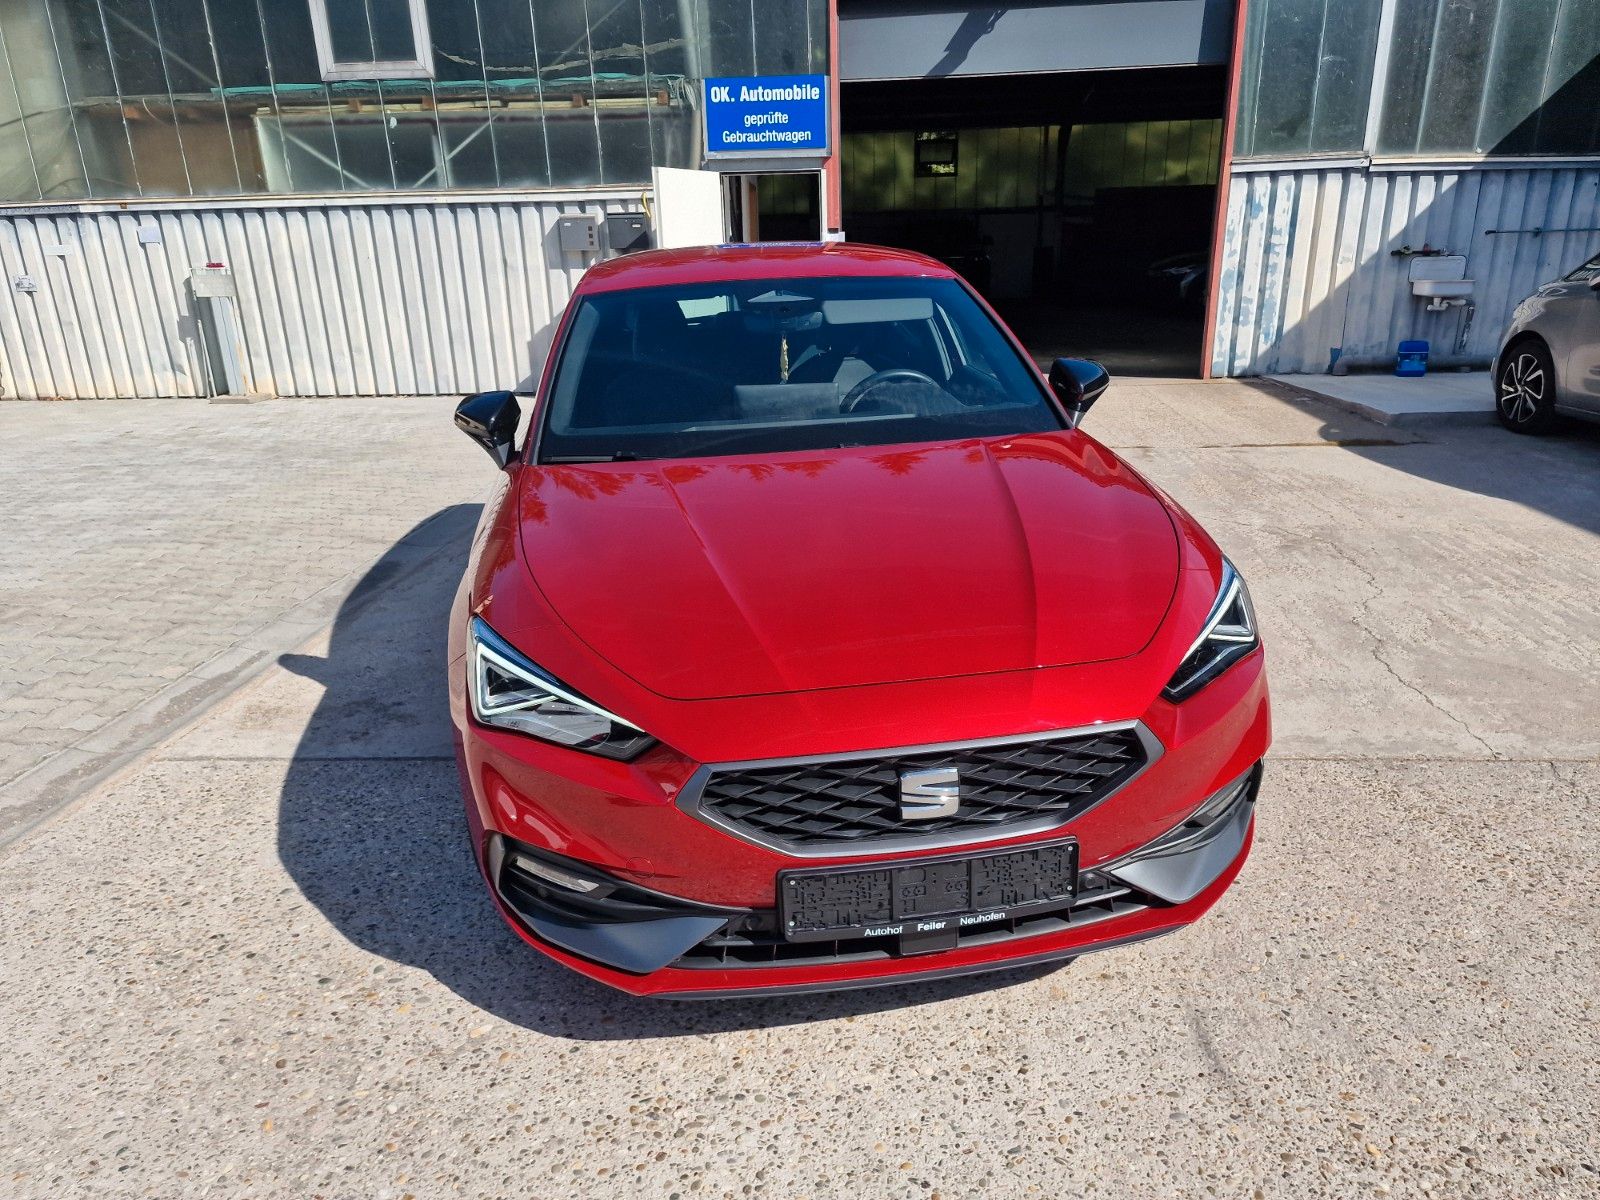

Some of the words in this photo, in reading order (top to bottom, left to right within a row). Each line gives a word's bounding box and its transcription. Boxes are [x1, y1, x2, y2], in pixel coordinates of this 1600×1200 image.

[710, 86, 735, 103] OK.
[740, 84, 820, 102] Automobile
[744, 111, 789, 127] geprüfte
[722, 130, 811, 143] Gebrauchtwagen
[864, 925, 903, 937] Autohof
[960, 911, 1006, 925] Neuhofen
